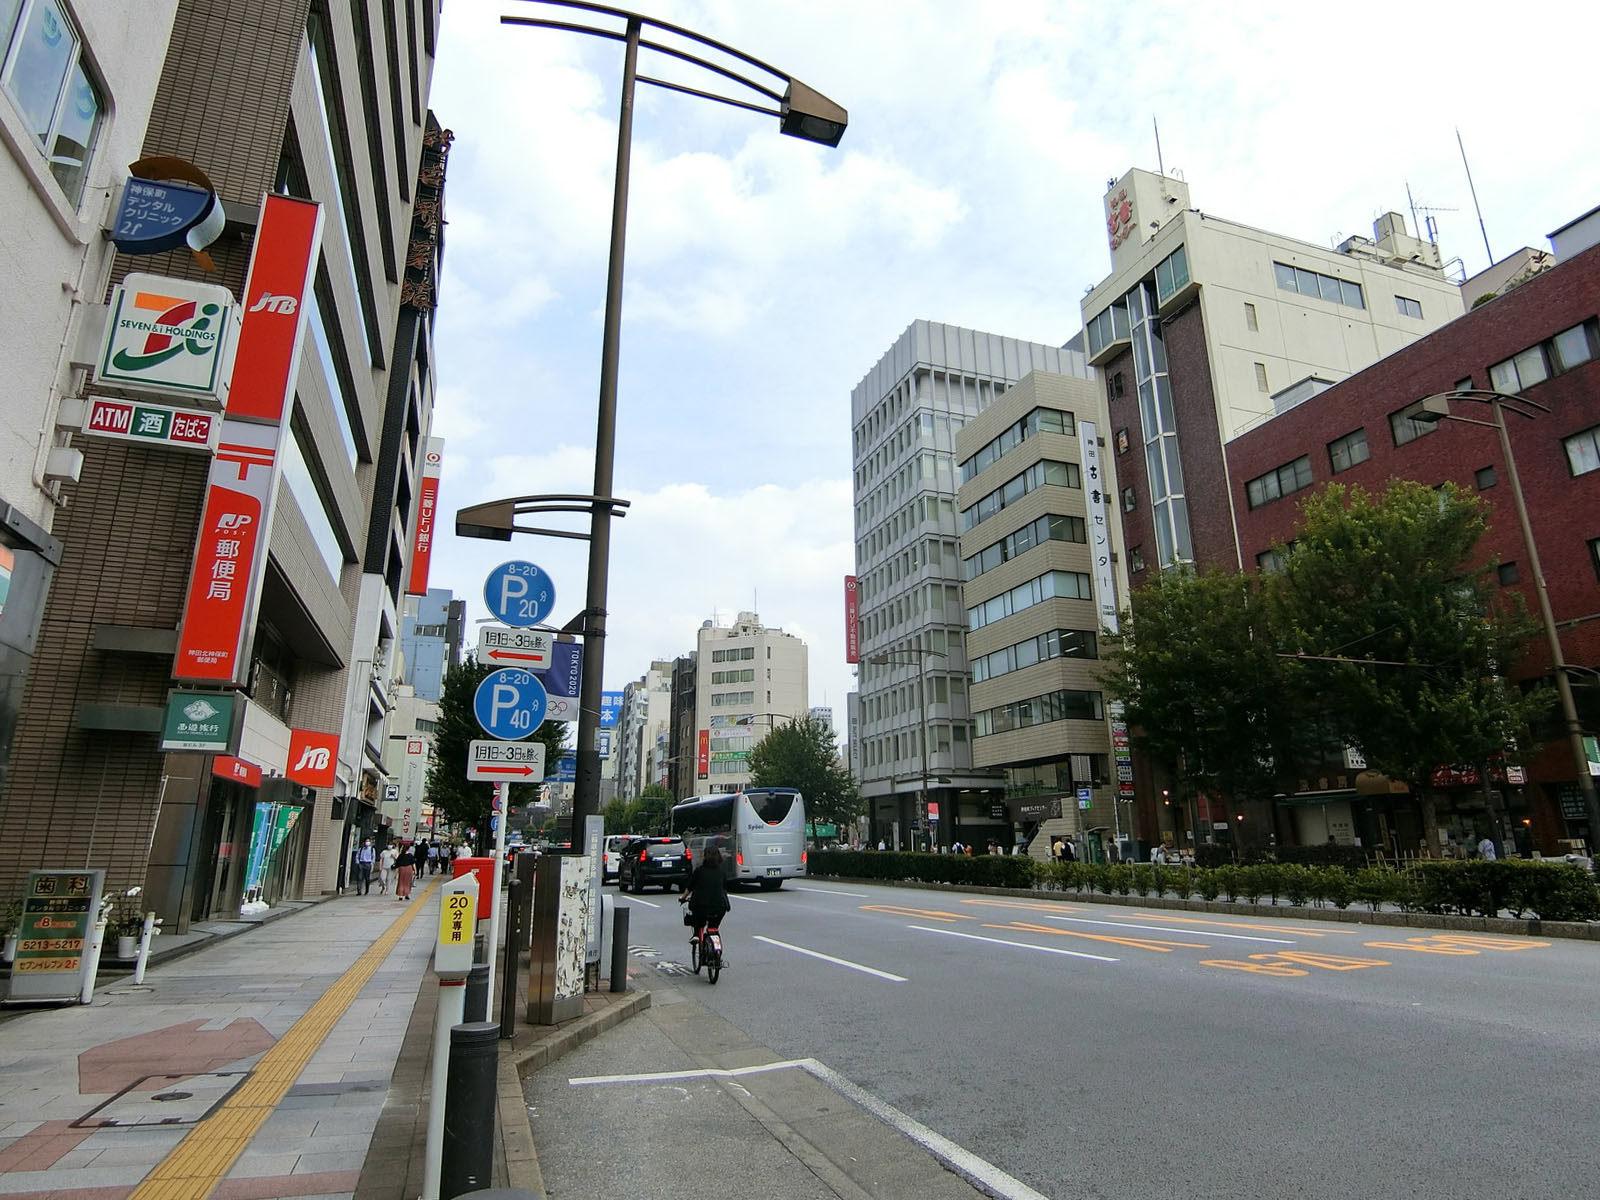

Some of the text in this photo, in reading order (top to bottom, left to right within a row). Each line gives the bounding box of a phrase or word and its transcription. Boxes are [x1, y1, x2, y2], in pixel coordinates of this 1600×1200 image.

[130, 184, 167, 199] 神保町
[127, 195, 175, 214] デンタル
[124, 207, 183, 225] クリニック
[249, 292, 298, 315] JTB
[120, 319, 151, 331] SEVEN
[165, 326, 216, 341] HOLDINGS
[92, 406, 131, 430] ATM
[138, 412, 165, 434] 酒
[173, 417, 209, 440] たばこ
[214, 528, 246, 536] POST
[206, 538, 239, 601] 郵便局
[508, 564, 538, 577] 8-20
[500, 574, 528, 616] P
[540, 590, 547, 602] 分
[519, 600, 538, 618] 20
[499, 672, 530, 685] 8-20
[568, 650, 580, 695] TOKYO 2020
[490, 684, 520, 728] P
[532, 699, 539, 711] 分
[509, 710, 530, 729] 40
[294, 745, 331, 771] JTB
[34, 876, 89, 896] 歯科
[449, 896, 468, 942] 20分専用
[23, 940, 81, 949] 5213-5217
[20, 960, 79, 970] セブンイレブン 2F
